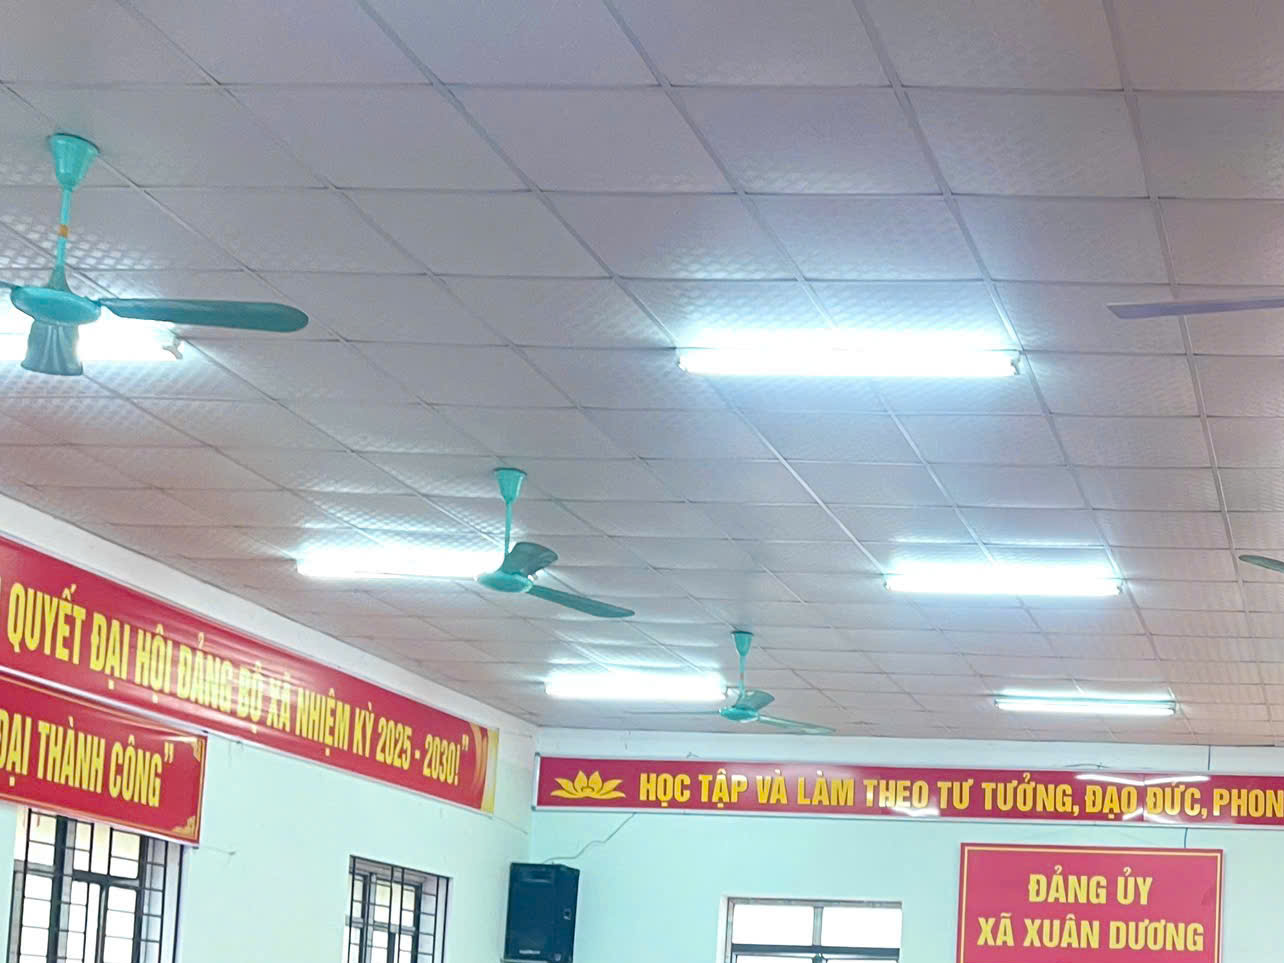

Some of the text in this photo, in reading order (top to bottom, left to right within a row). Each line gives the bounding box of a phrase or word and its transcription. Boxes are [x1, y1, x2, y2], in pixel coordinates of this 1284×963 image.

[7, 582, 87, 665] QUYẾT
[89, 612, 131, 690] ĐẠI
[135, 623, 174, 704] HỘI
[176, 631, 234, 714] ĐẢNG
[236, 660, 263, 734] BỘ
[295, 687, 351, 757] NHIỆM
[352, 701, 375, 759] KỲ
[375, 716, 413, 771] 2025
[36, 715, 106, 794] THÀNH
[639, 772, 691, 807] HỌC
[698, 768, 748, 808] TẬP
[756, 768, 788, 805] VÀ
[797, 770, 855, 807] LÀM
[863, 779, 929, 809] THEO
[937, 778, 974, 810] TƯ
[981, 772, 1080, 817] TƯỞNG,
[1084, 784, 1138, 819] ĐẠO
[1146, 780, 1207, 819] ĐỨC,
[1028, 864, 1153, 905] ĐẢNG ỦY
[976, 912, 1204, 952] XÃ XUÂN DƯƠNG
